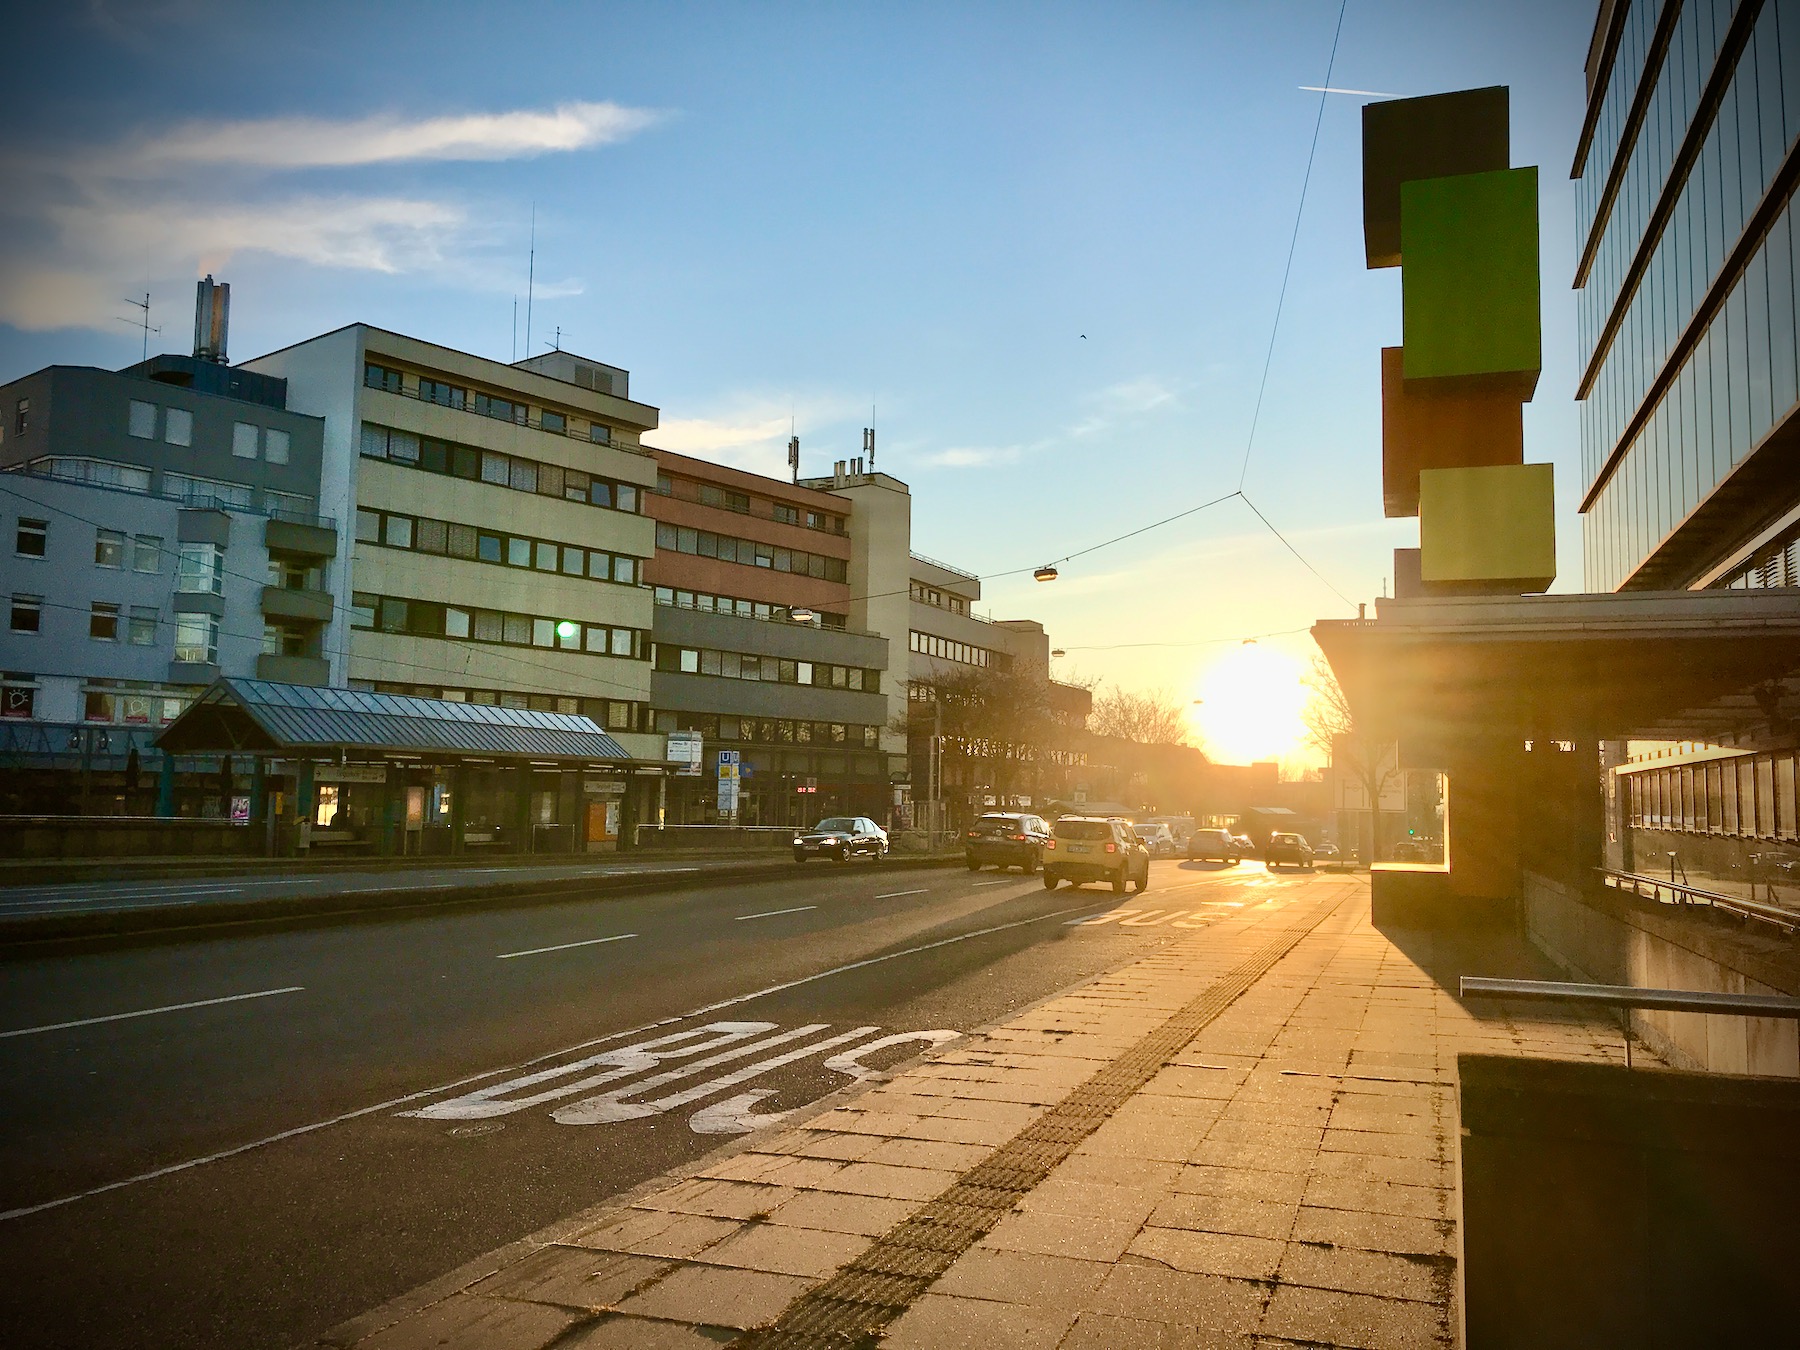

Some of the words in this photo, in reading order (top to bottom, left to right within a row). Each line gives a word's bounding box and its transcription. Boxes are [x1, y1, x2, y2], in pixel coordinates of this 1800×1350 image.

[721, 752, 730, 762] U
[1061, 909, 1229, 927] BUS
[391, 1020, 962, 1134] BUS
